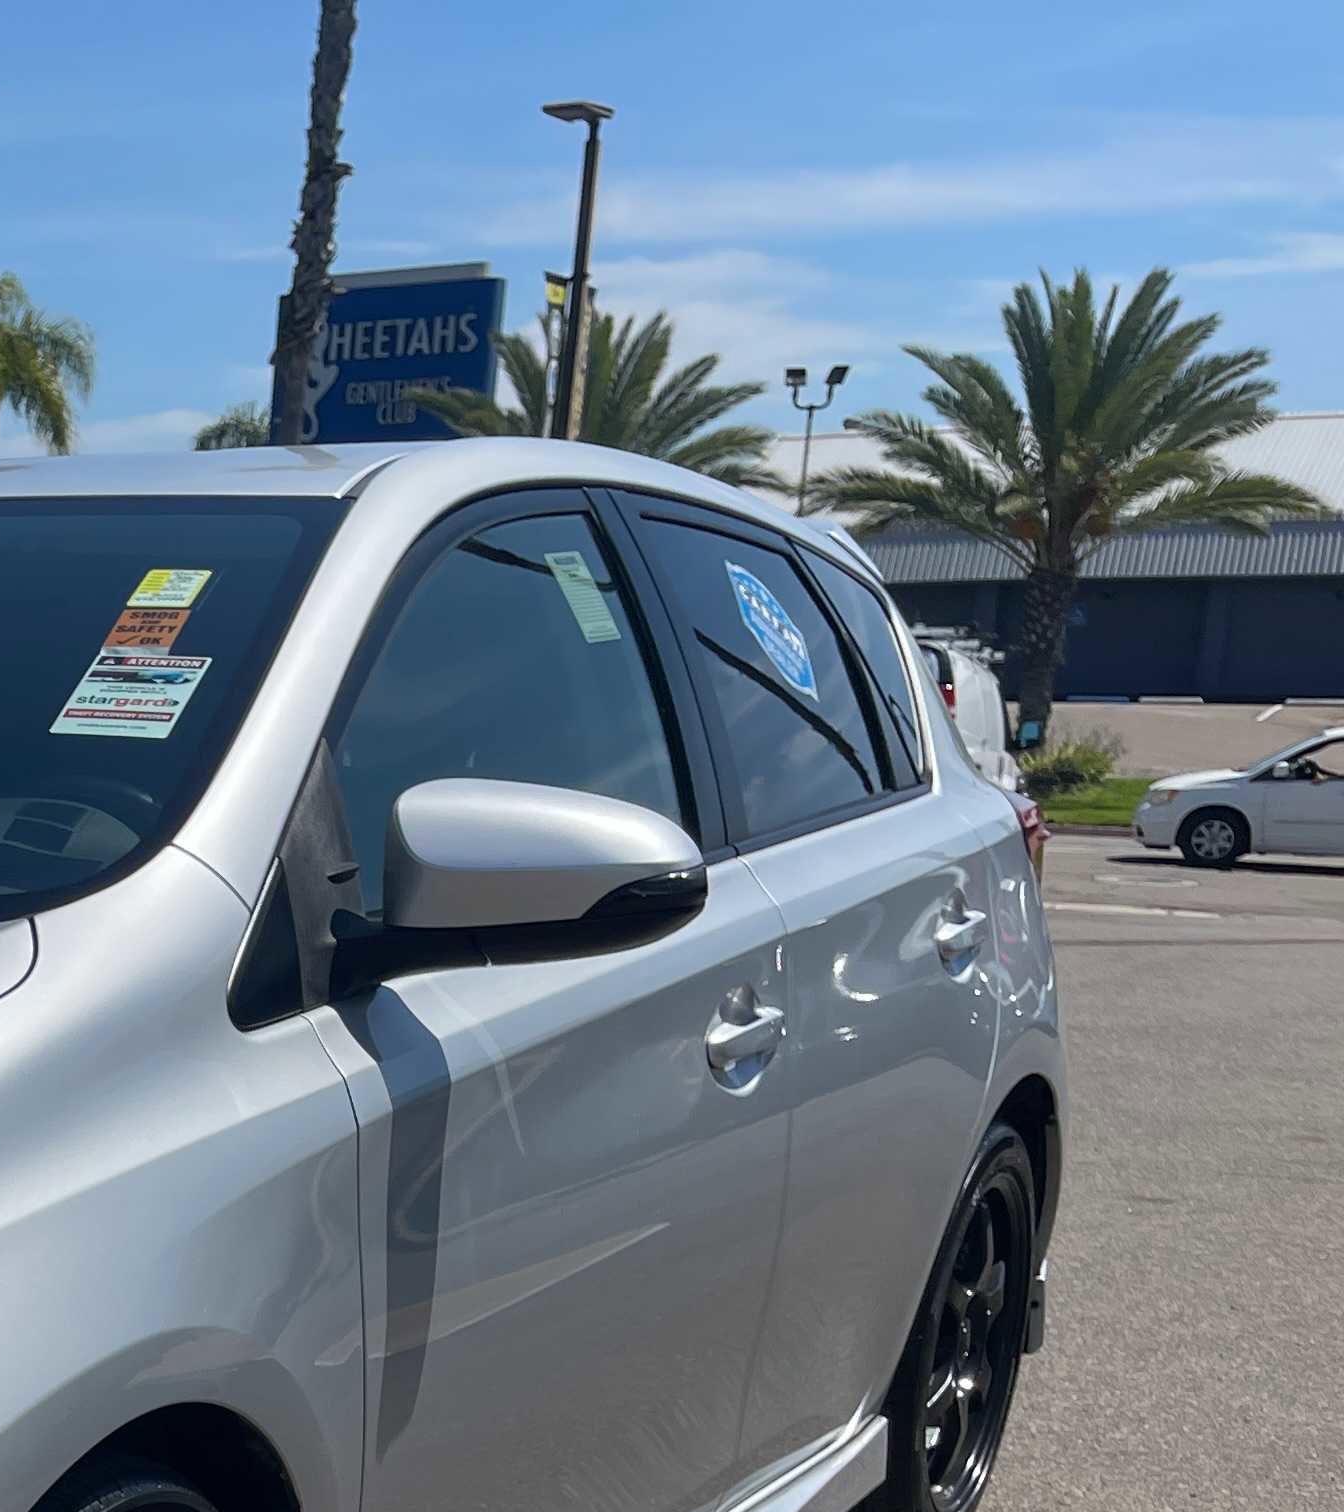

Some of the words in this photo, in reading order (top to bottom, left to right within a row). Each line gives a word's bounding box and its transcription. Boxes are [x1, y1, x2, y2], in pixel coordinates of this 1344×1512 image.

[327, 313, 479, 361] HEETAHS
[376, 401, 417, 425] CLUB
[129, 611, 180, 620] SMOG
[115, 625, 177, 634] SAFETY
[140, 637, 163, 645] OK
[127, 658, 202, 668] ATTENTION
